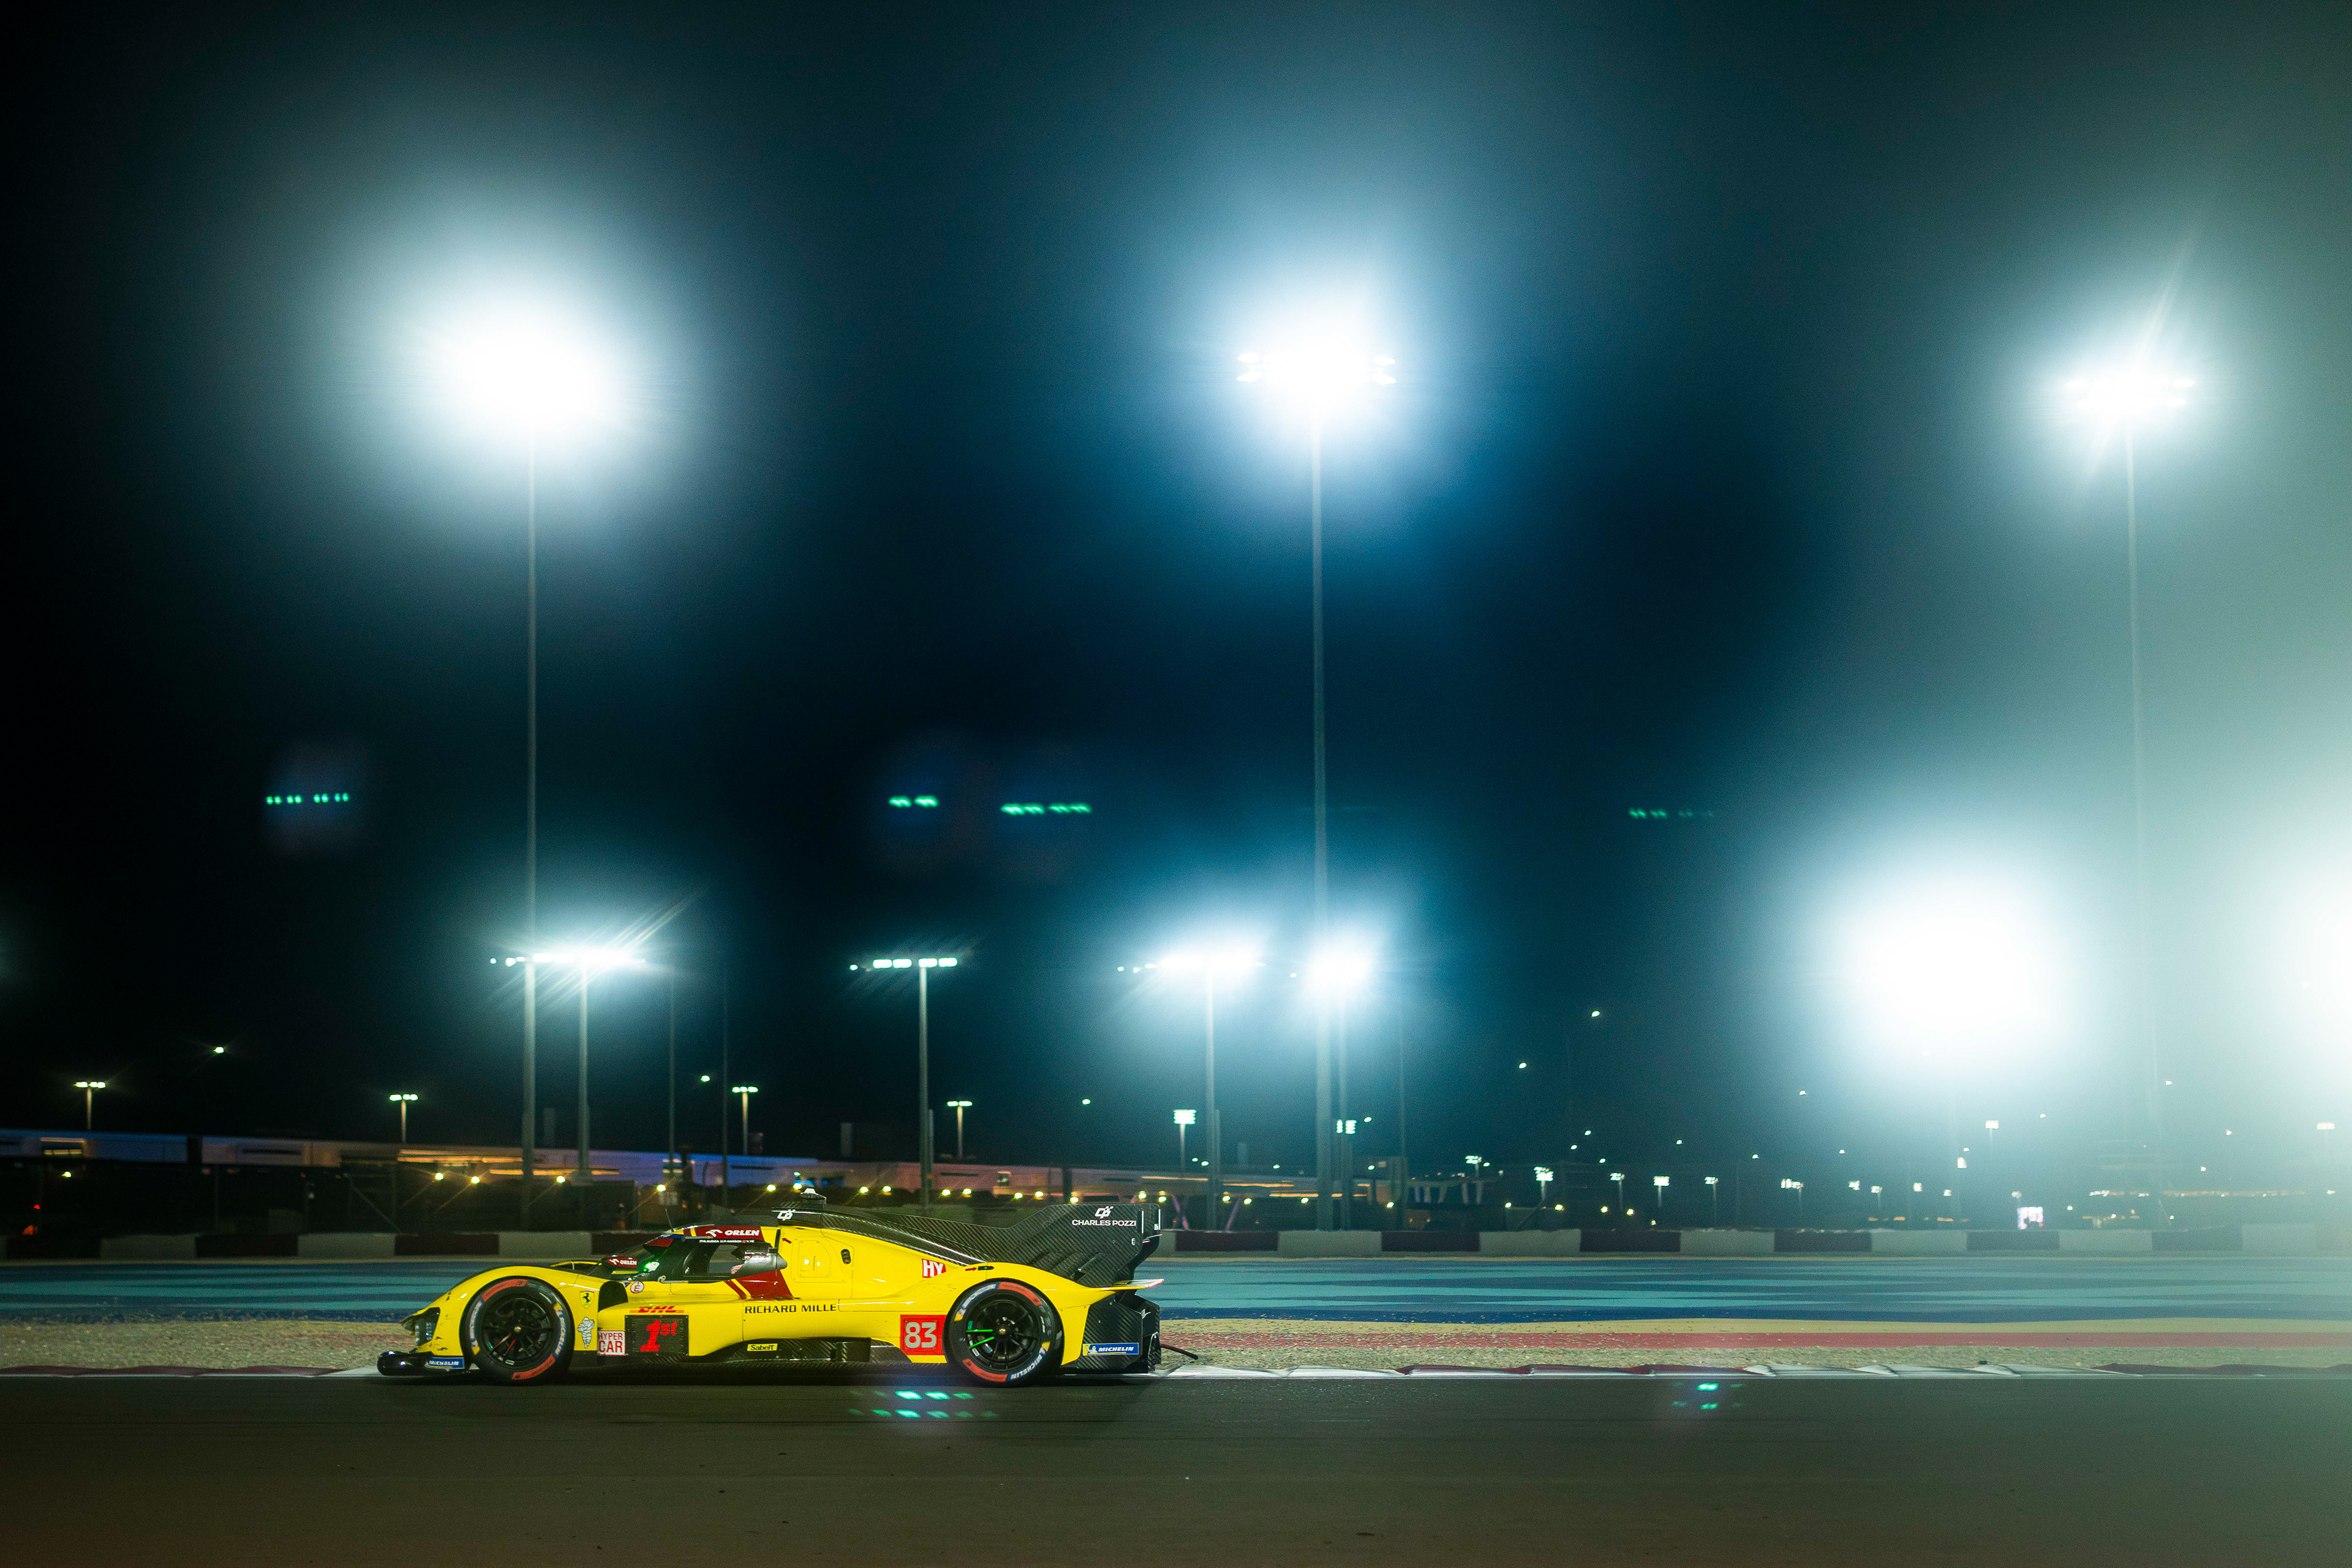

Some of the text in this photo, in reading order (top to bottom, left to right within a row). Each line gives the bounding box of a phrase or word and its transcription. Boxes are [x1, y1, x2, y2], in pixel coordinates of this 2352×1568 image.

[922, 1259, 944, 1277] HY
[745, 1305, 796, 1314] RICHARD
[905, 1322, 937, 1349] 83
[598, 1340, 623, 1353] CAR
